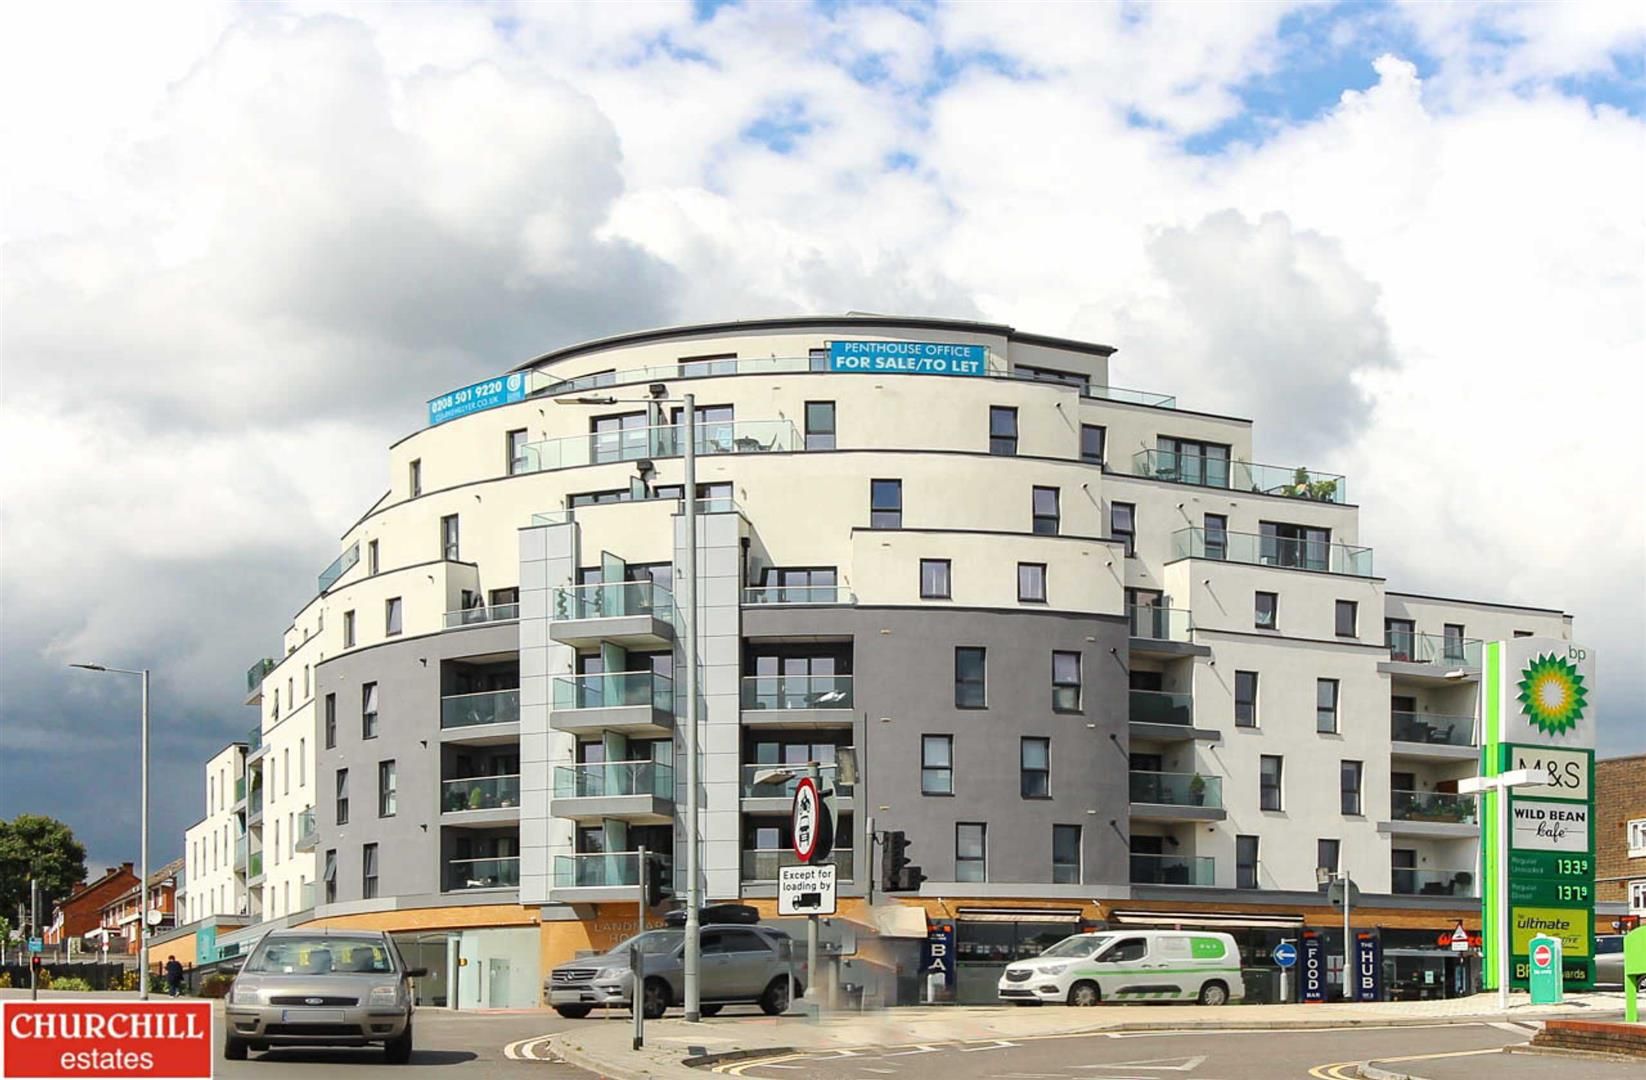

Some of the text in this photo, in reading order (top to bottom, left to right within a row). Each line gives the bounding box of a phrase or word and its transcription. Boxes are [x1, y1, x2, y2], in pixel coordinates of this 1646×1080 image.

[844, 342, 971, 357] PENTHOUSE OFFICE
[836, 356, 979, 373] FOR SALE/TO LET
[431, 381, 502, 413] 0208 501 9220
[1569, 645, 1586, 663] bp
[1514, 808, 1585, 822] WILD BEAN
[783, 869, 831, 880] Except for
[783, 880, 831, 892] loading by
[1517, 917, 1570, 930] ultimate
[1307, 948, 1319, 990] FOOD
[1361, 950, 1374, 989] HUB
